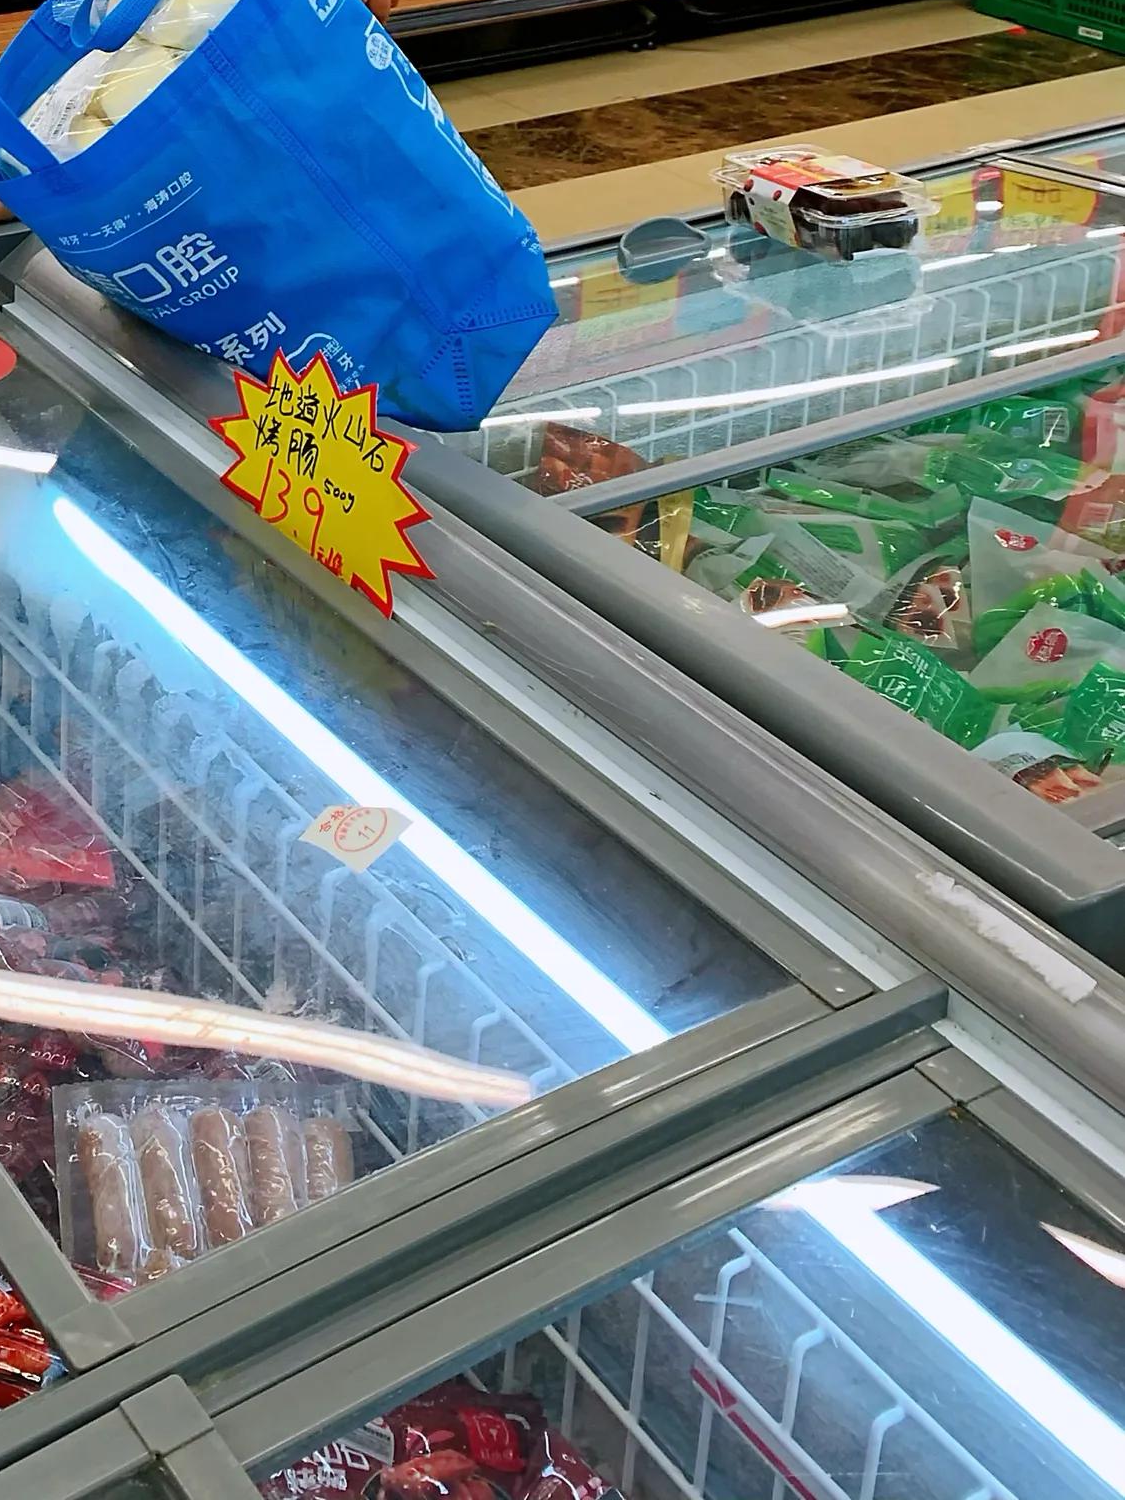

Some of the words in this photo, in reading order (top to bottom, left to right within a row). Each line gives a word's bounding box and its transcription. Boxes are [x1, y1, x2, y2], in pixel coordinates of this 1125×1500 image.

[177, 265, 240, 308] GROUP
[253, 414, 321, 480] 烤肠
[264, 375, 389, 473] 地道火山石
